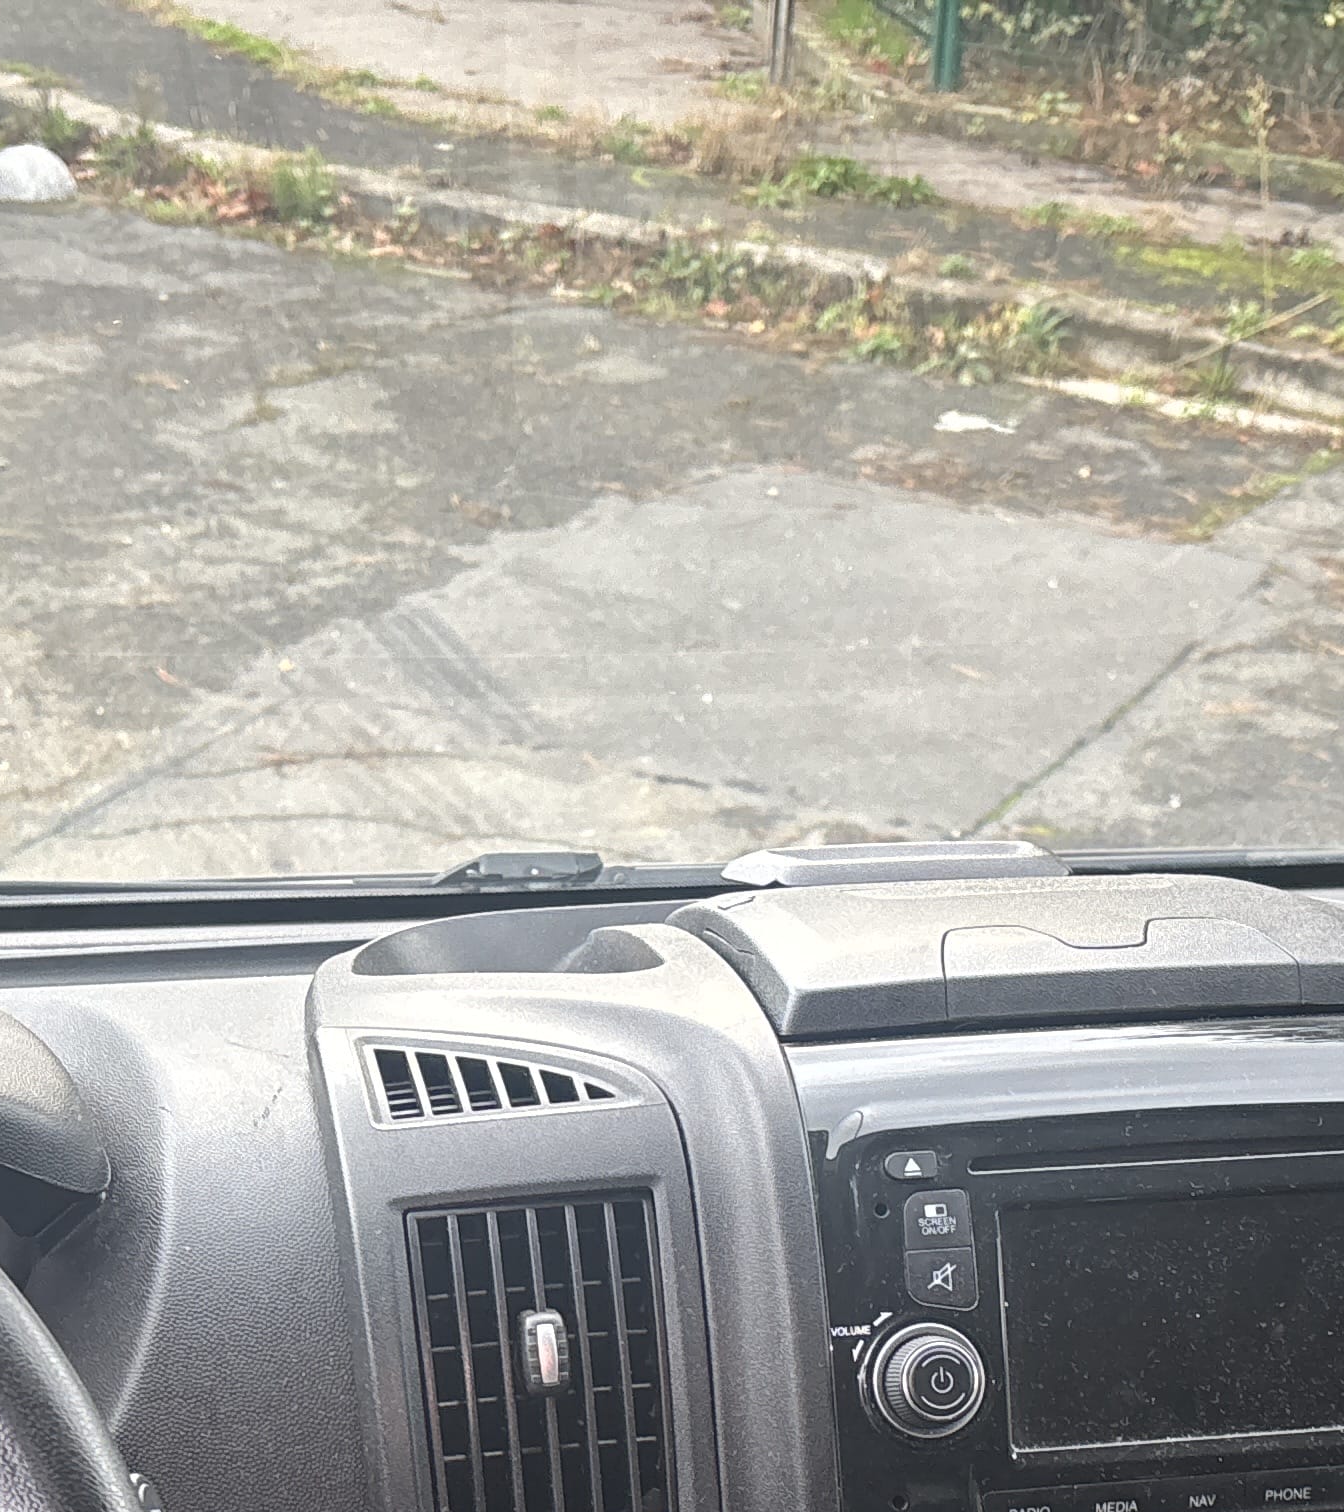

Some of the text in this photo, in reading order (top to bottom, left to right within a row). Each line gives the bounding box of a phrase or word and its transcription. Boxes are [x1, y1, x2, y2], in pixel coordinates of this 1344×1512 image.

[917, 1216, 957, 1227] SCREEN
[920, 1226, 957, 1237] ON/OFF
[830, 1325, 871, 1337] VOLUME
[1264, 1486, 1313, 1504] PHONE
[1188, 1493, 1217, 1510] NAV
